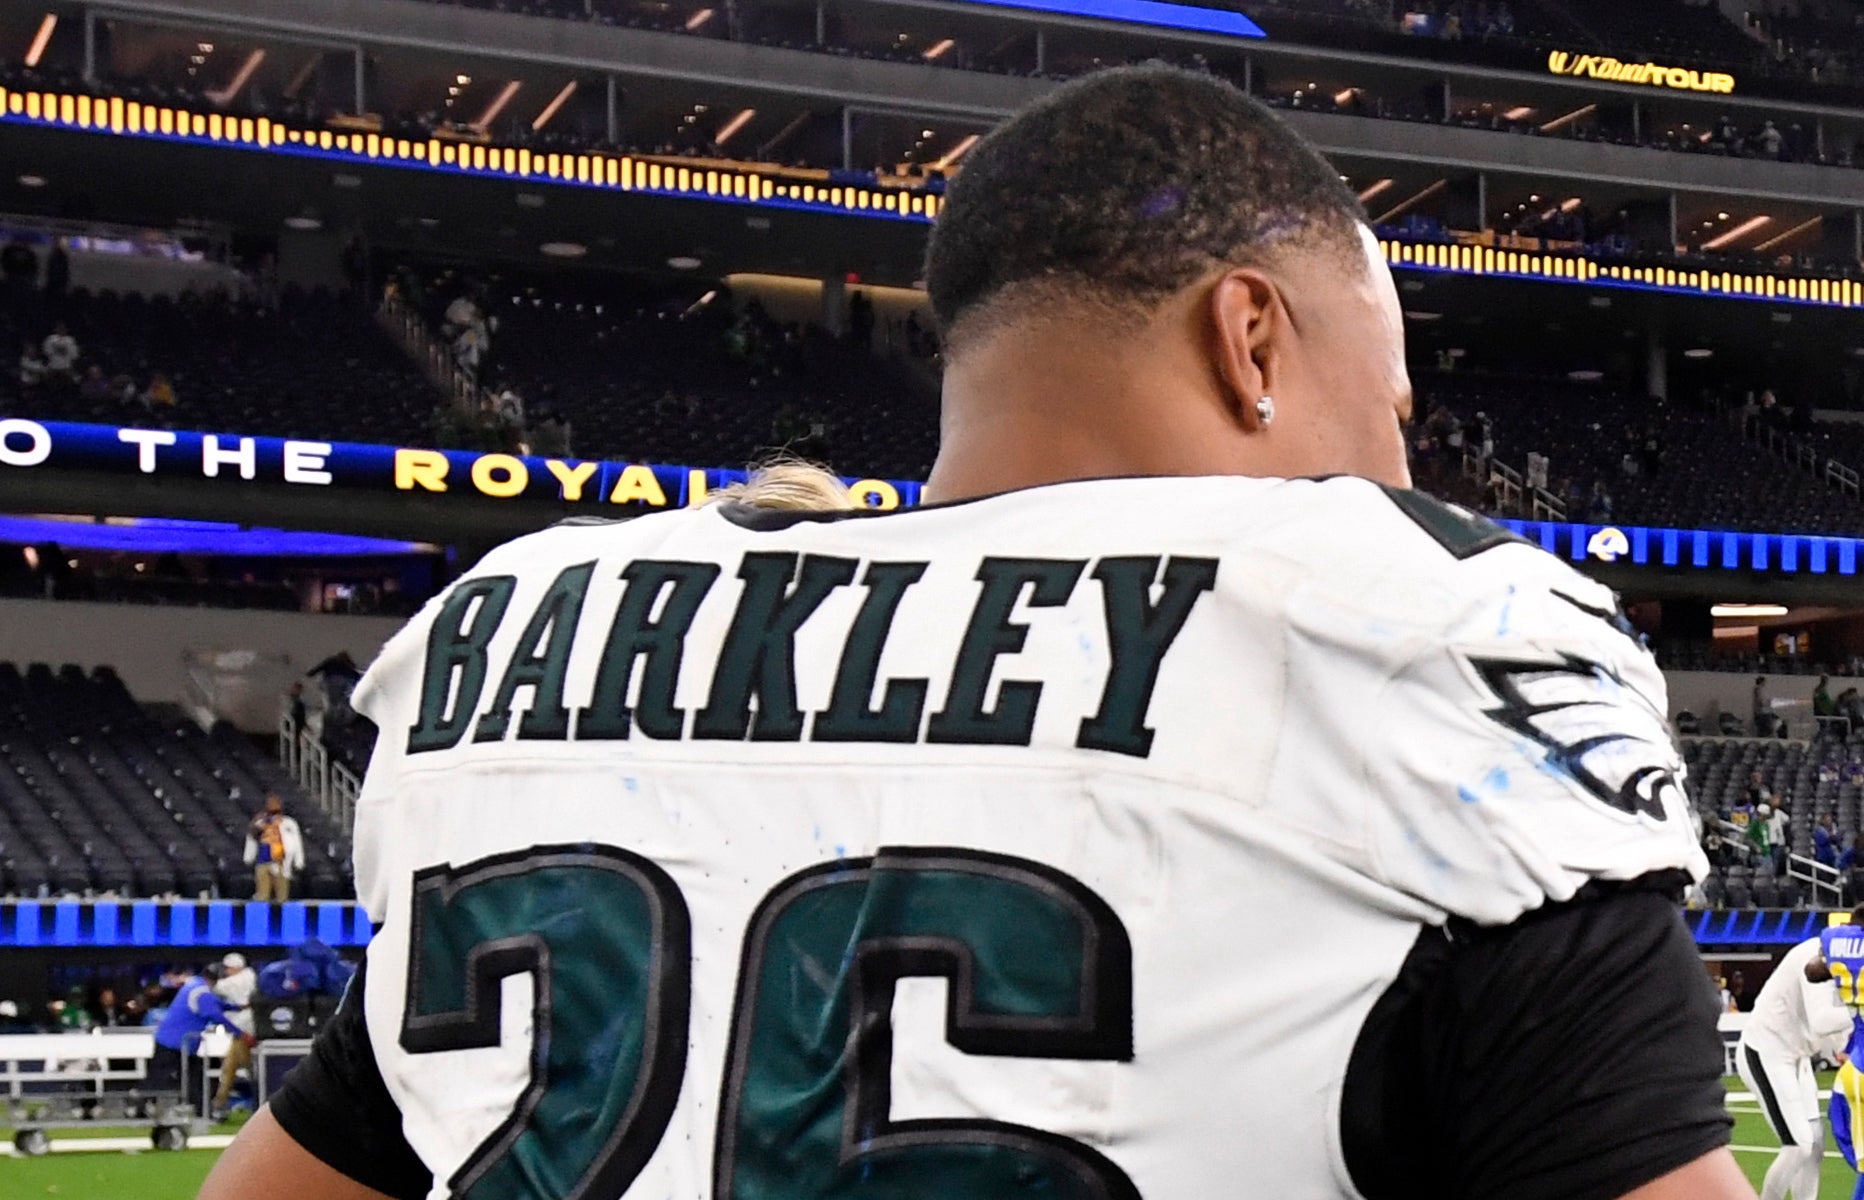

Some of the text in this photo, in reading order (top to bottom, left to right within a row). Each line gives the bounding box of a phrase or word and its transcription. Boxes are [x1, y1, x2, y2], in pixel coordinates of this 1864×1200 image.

[118, 428, 333, 485] THE
[395, 448, 712, 510] ROYAL
[405, 551, 1220, 760] BARKLEY
